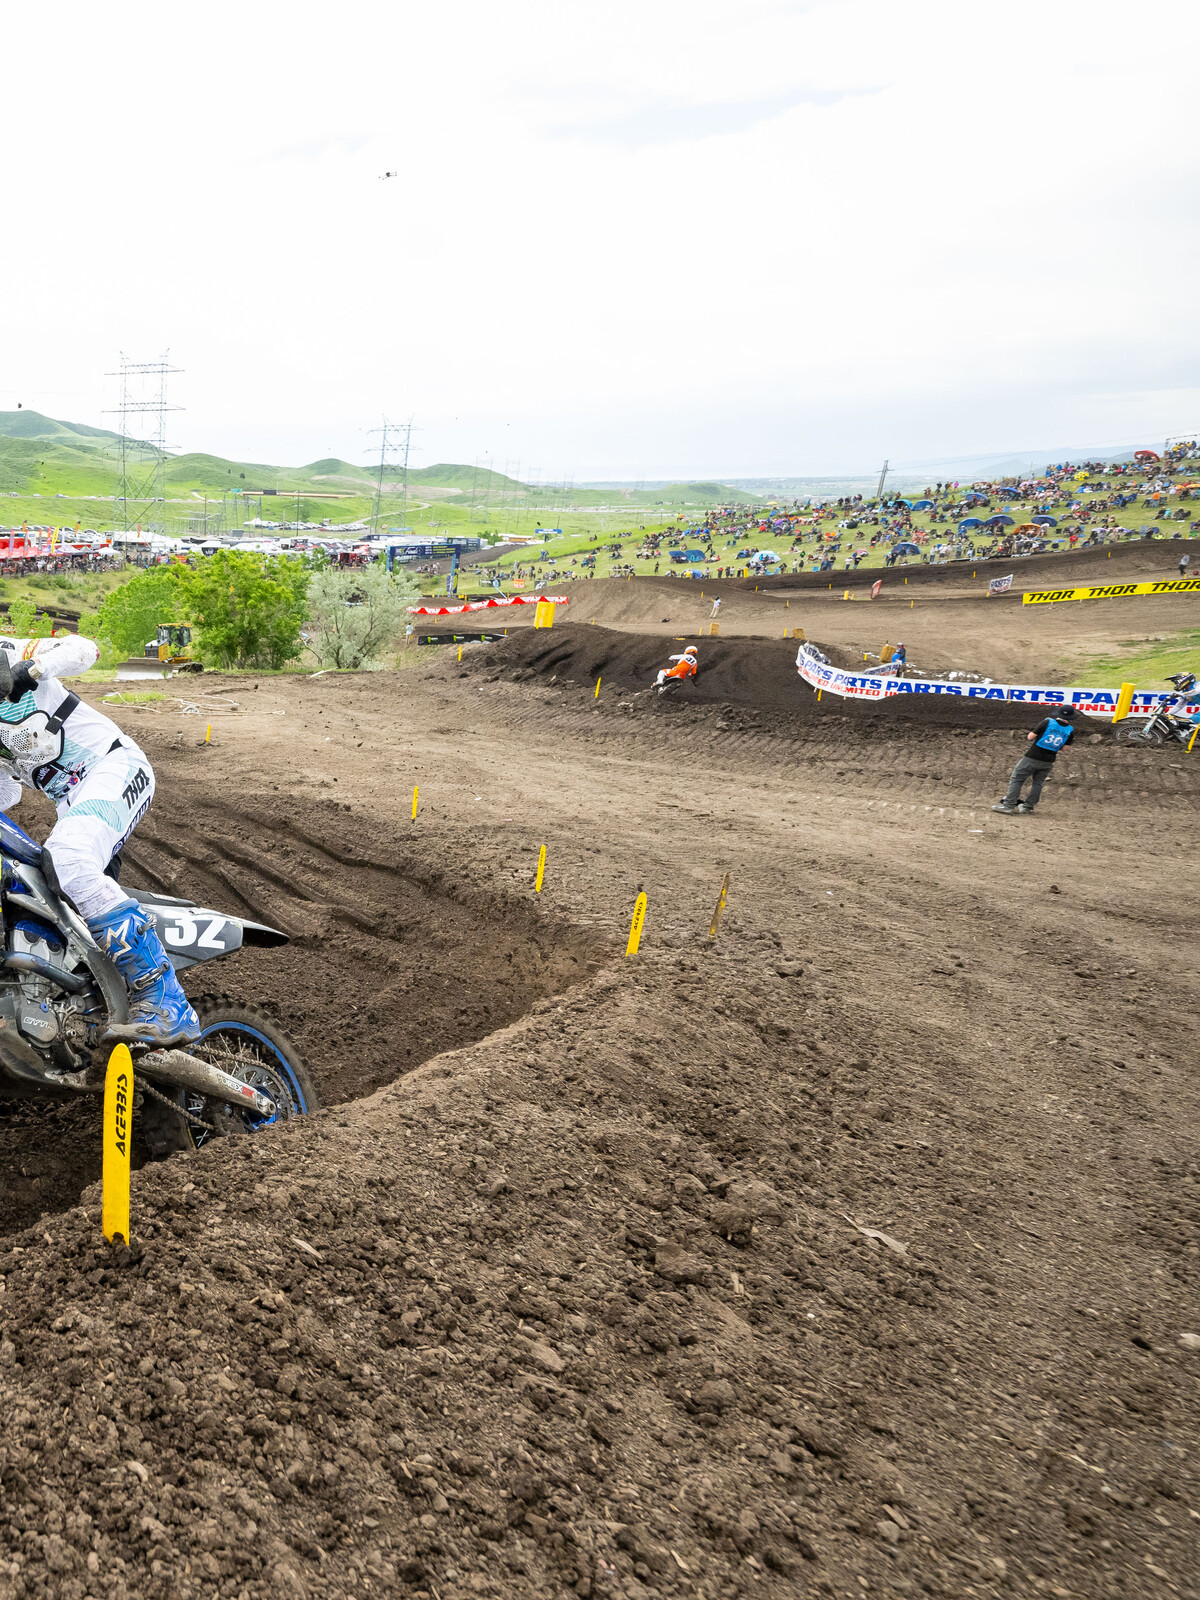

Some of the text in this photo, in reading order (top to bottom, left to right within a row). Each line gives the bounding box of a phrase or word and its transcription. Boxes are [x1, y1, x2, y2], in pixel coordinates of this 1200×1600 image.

[1029, 580, 1200, 601] THOR THOR THOR
[886, 680, 962, 695] PARTS
[968, 686, 1064, 703] PARTS
[1044, 734, 1064, 746] 30
[163, 909, 228, 950] 32
[116, 1073, 128, 1157] ACERBIS
